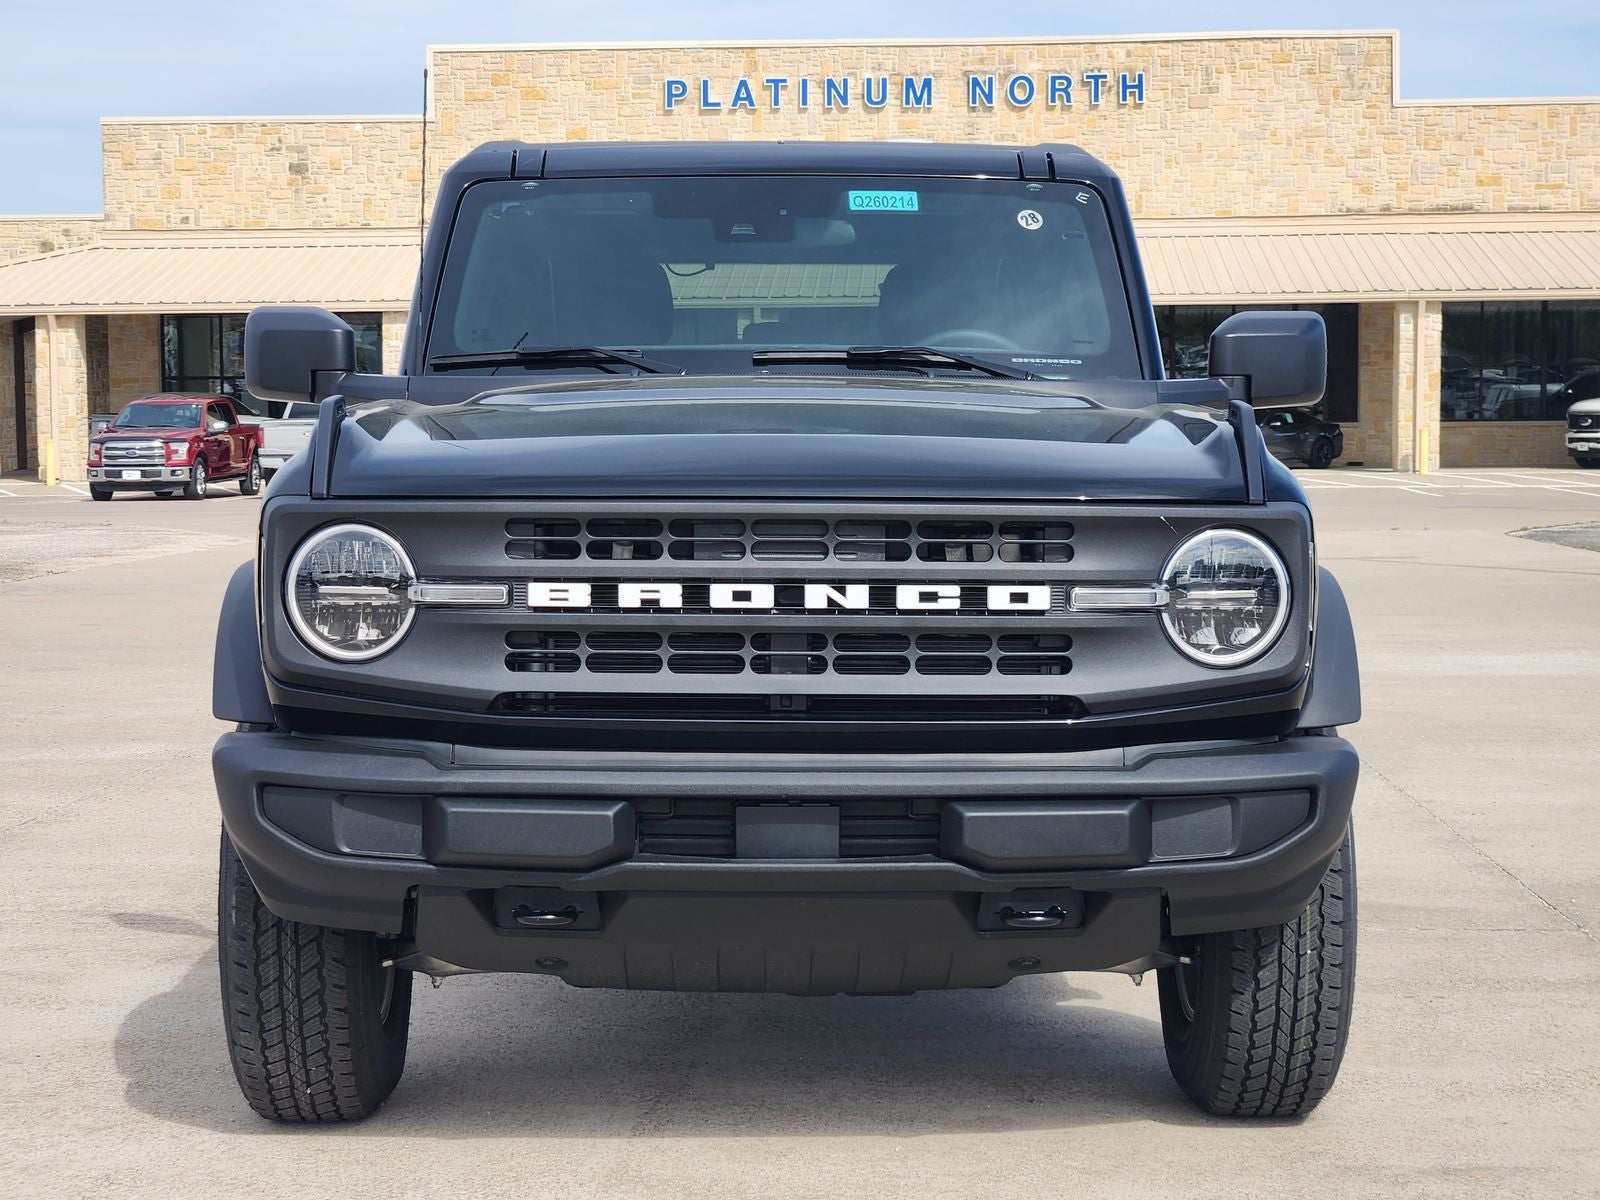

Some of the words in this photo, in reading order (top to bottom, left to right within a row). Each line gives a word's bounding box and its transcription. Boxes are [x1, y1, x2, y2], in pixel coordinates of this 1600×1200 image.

[664, 75, 933, 110] PLATINUM
[968, 71, 1145, 107] NORTH
[853, 195, 915, 208] Q260214
[1020, 212, 1040, 227] 28
[527, 582, 1052, 611] BRONCO
